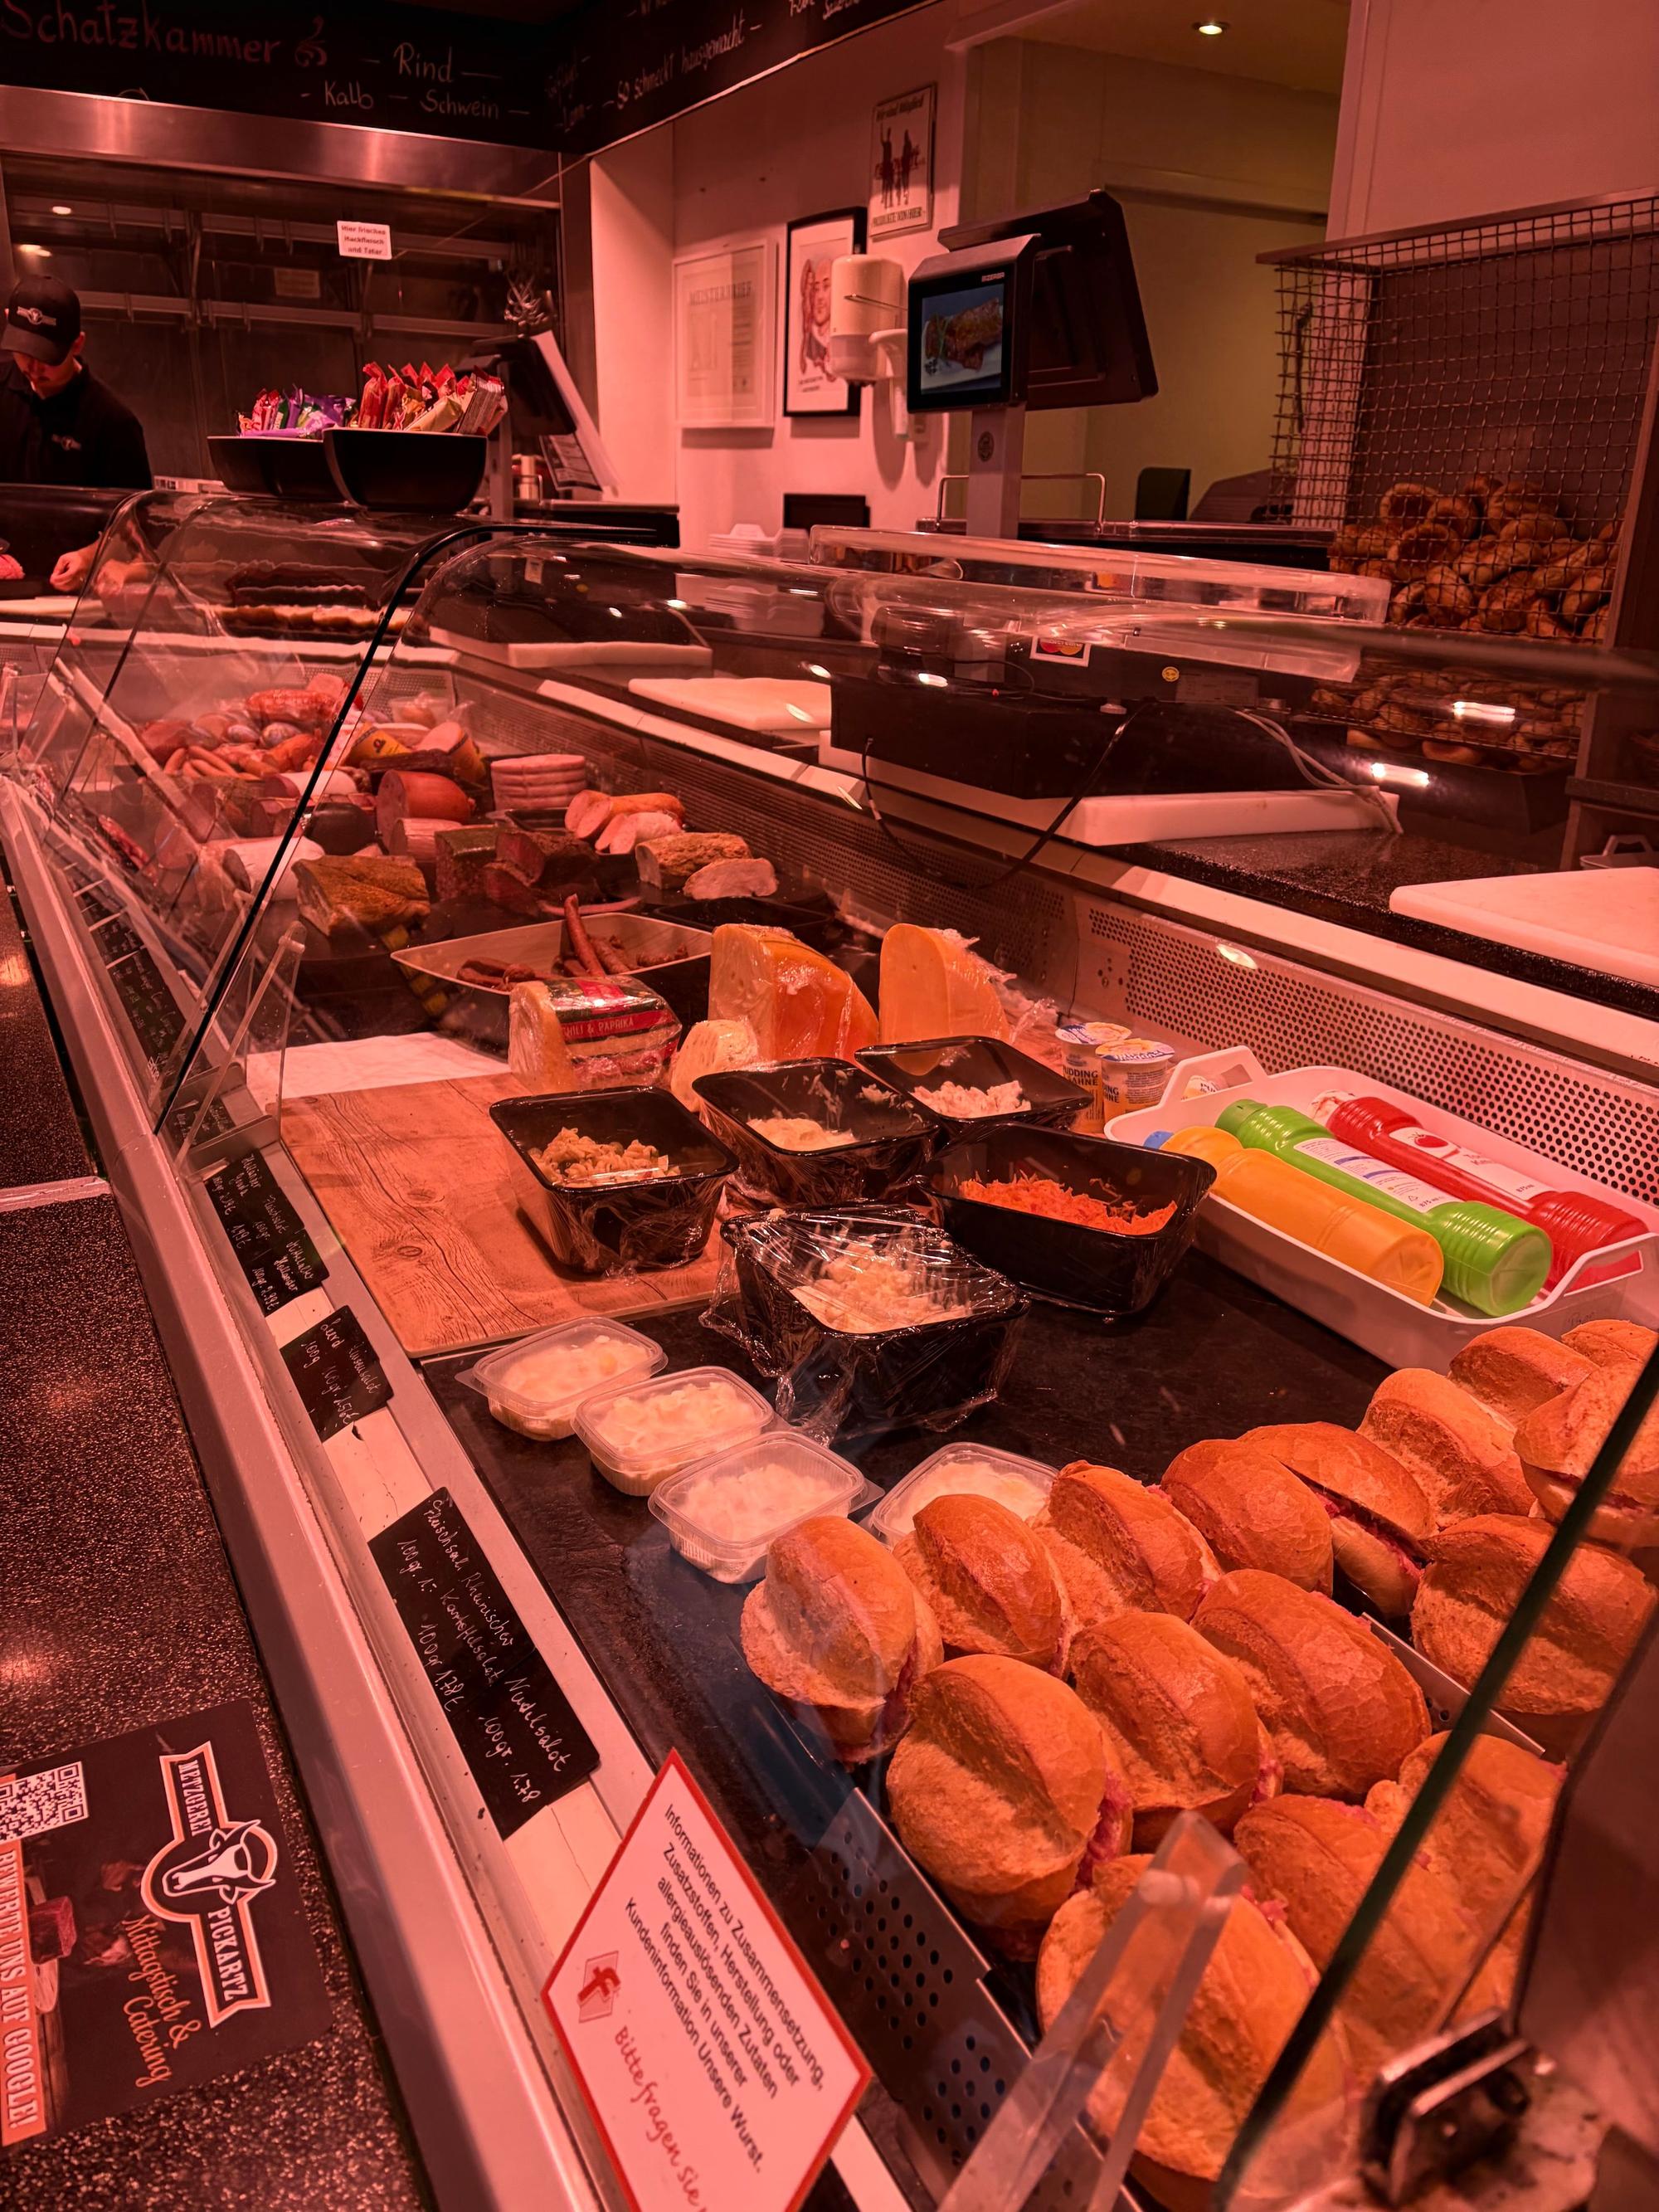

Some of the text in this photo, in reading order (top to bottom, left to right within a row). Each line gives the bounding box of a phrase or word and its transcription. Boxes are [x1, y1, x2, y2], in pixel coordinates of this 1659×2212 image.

[2, 0, 281, 63] Schatzkammer
[393, 41, 454, 84] Rind
[682, 8, 746, 71] hausgemacht
[324, 80, 499, 119] Kalb Schwein
[598, 1016, 635, 1032] PAPRIKA
[1071, 1076, 1099, 1086] AHNE
[424, 1499, 469, 1571] Fleischsal
[461, 1571, 514, 1646] Rheinischer
[504, 1677, 571, 1772] Nudelsalat
[178, 1759, 212, 1837] METZGEREI
[510, 1773, 542, 1803] 1.78
[0, 1937, 26, 1982] UNS
[121, 1913, 202, 2050] Mittagstisch &
[207, 1906, 249, 2002] PICKARTZ
[663, 1841, 800, 2087] Zusatzstoffen, Herstellung oder
[664, 1803, 824, 2091] Informationen zu Zusammensetzung,
[1, 1984, 31, 2024] AUF
[657, 1876, 778, 2100] allergieauslösenden Zutaten
[660, 1921, 748, 2088] finden Sie in unserer
[123, 1995, 173, 2088] Catering
[625, 1896, 763, 2175] Kundeninformation Unsere Wurst.
[3, 2027, 39, 2129] GOOGLE!
[615, 2025, 700, 2207] Bitte fragen Sie
